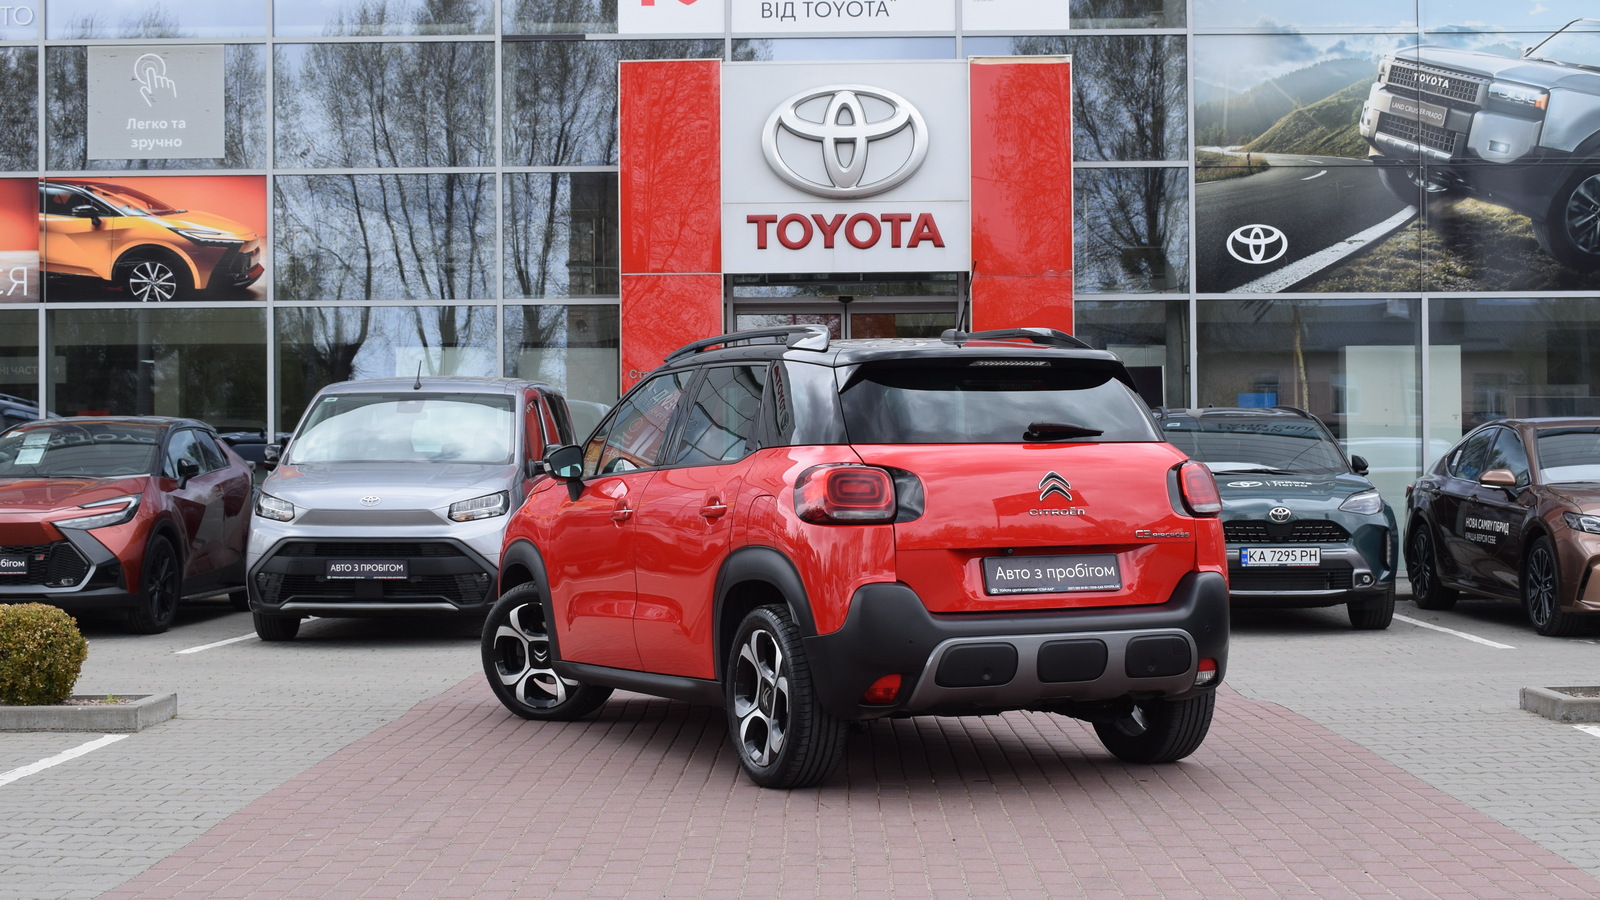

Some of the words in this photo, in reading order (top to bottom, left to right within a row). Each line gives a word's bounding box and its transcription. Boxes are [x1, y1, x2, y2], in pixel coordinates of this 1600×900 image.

[761, 1, 797, 22] ВІД
[802, 0, 896, 18] TOYOTA
[1413, 73, 1449, 88] TOYOTA
[1391, 101, 1405, 111] LAND
[1425, 110, 1443, 120] PRADO
[126, 118, 168, 130] Легко
[171, 119, 186, 129] та
[130, 138, 182, 151] зручно
[746, 212, 945, 250] TOYOTA
[1465, 517, 1479, 529] НОВА
[1135, 529, 1151, 538] C3
[1248, 550, 1266, 562] KA
[1270, 550, 1297, 562] 7295
[1300, 550, 1317, 562] PH
[330, 563, 352, 572] АВТО
[360, 563, 404, 572] ПРОБІГОМ
[995, 566, 1031, 580] Авто
[1034, 568, 1043, 579] з
[1046, 563, 1115, 581] пробігом
